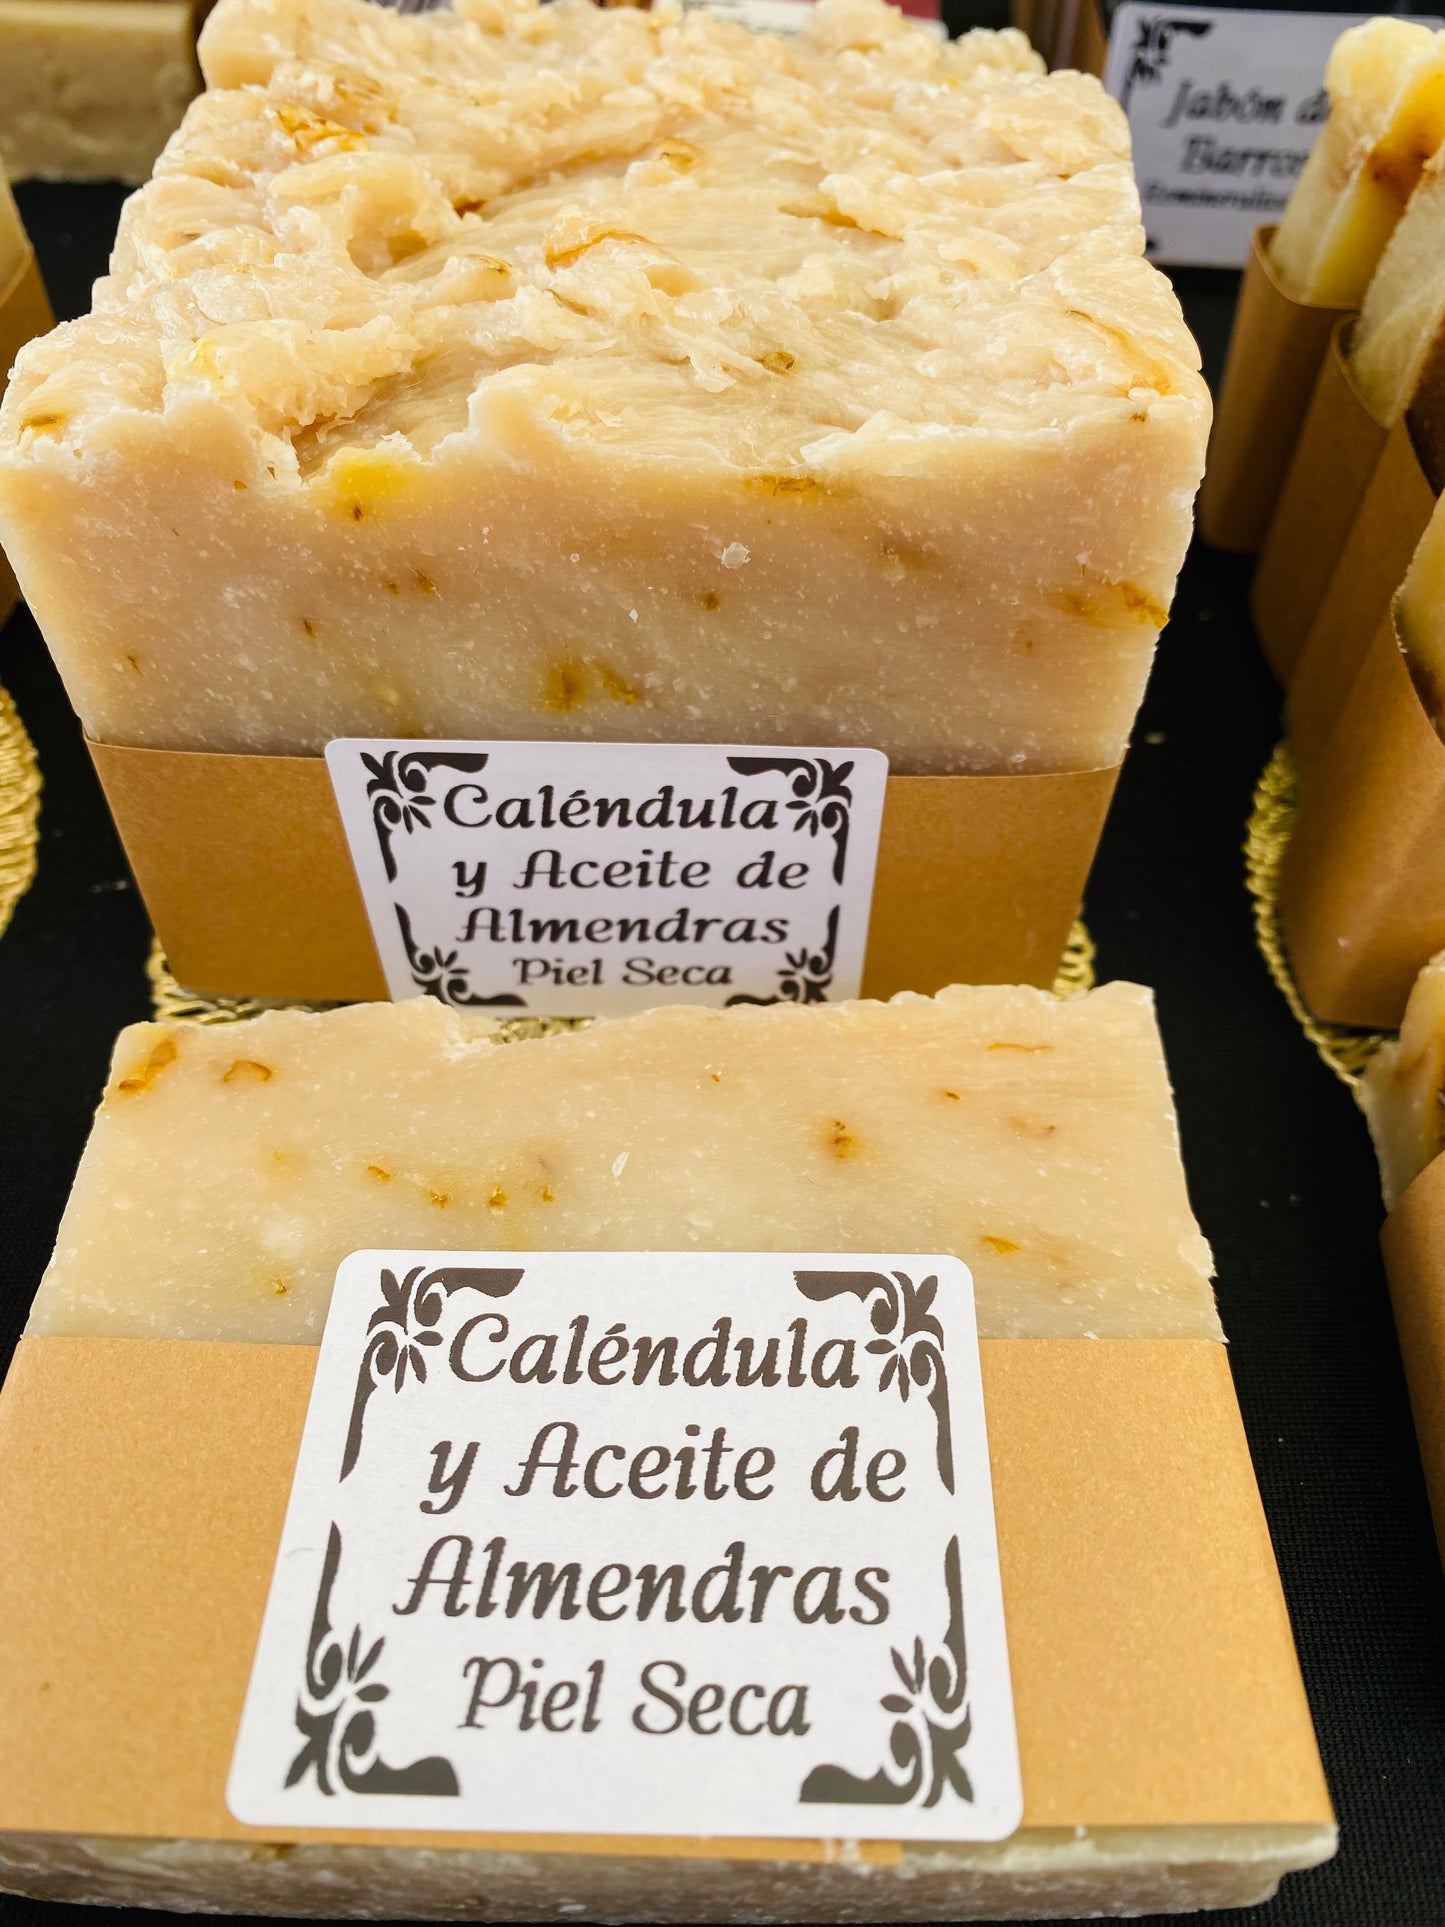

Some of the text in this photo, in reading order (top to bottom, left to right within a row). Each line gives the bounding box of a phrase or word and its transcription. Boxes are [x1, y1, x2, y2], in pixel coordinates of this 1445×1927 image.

[1295, 88, 1331, 125] d
[443, 783, 779, 830] Caléndula
[451, 848, 810, 898] y Aceite de
[455, 907, 789, 944] Almendras
[512, 957, 733, 987] Piel Seca
[448, 1313, 860, 1389] Caléndula
[420, 1421, 907, 1515] y Aceite de
[392, 1534, 890, 1625] Almendras
[457, 1655, 811, 1736] Piel Seca
